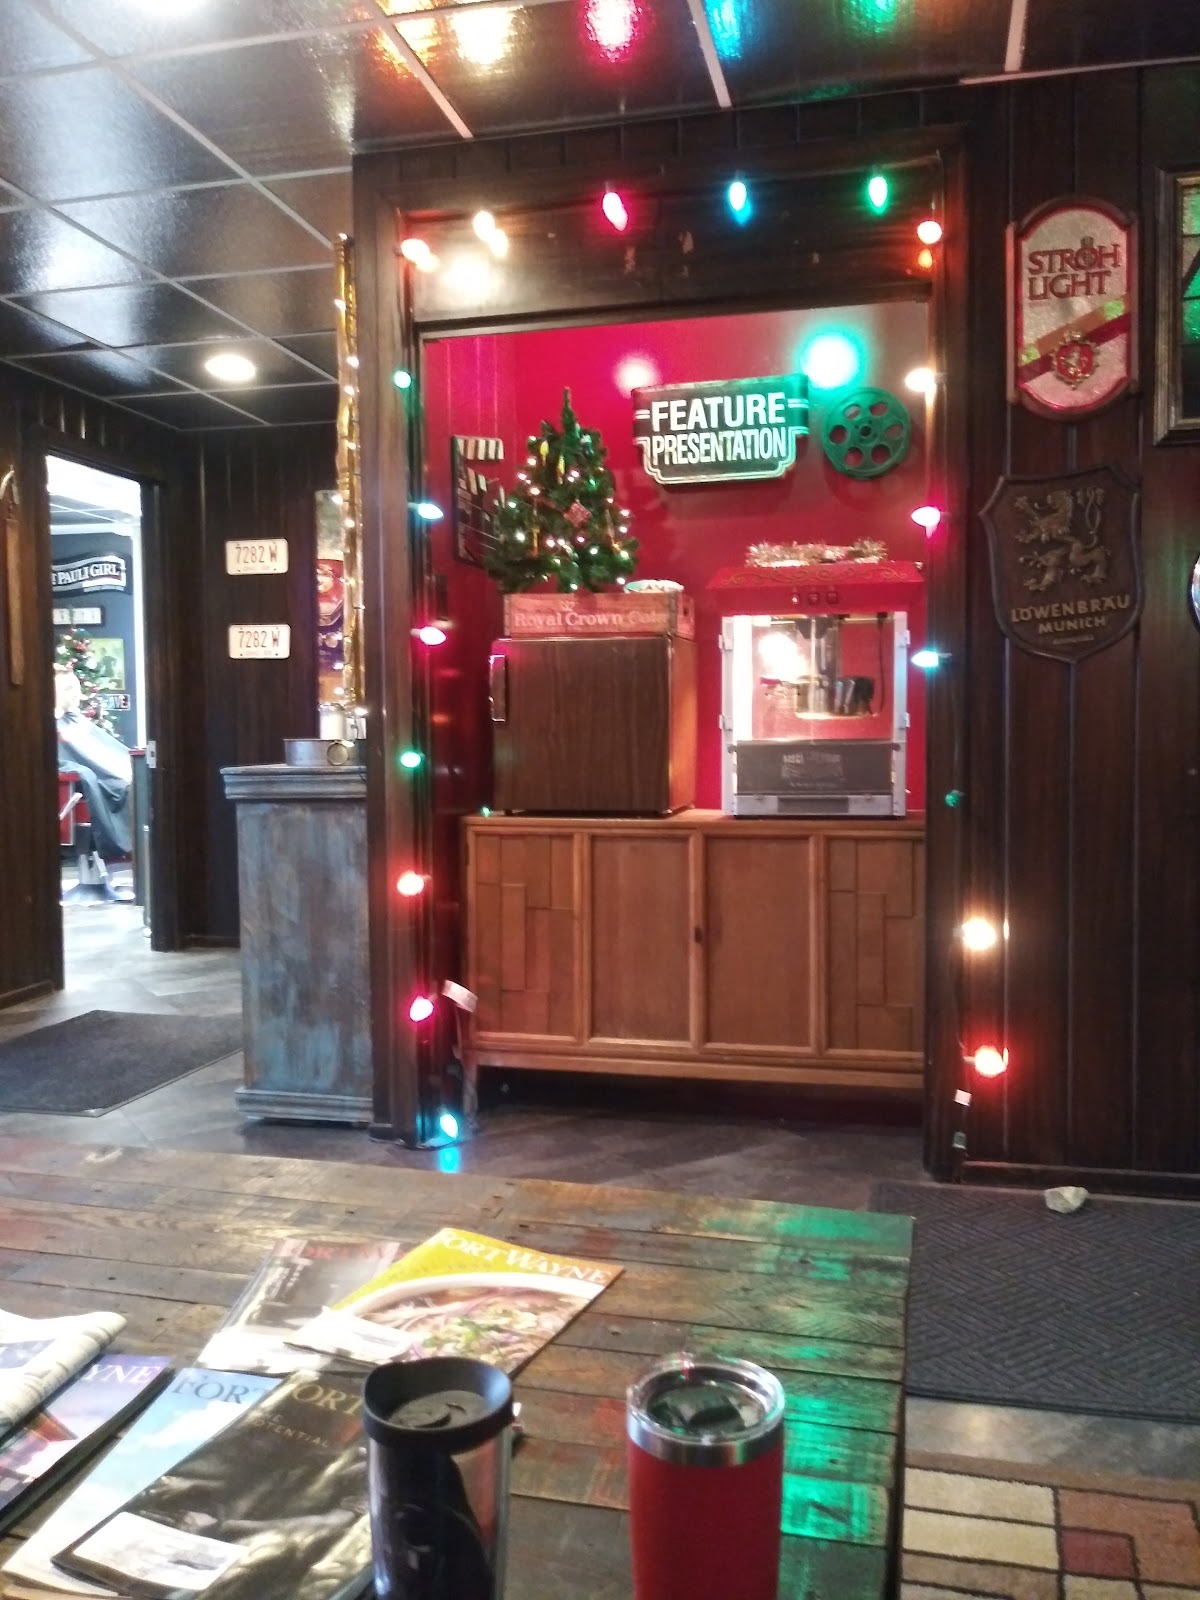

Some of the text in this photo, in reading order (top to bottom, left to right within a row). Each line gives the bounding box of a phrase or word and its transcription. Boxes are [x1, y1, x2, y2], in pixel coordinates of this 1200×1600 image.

[1027, 243, 1120, 275] STROH
[1028, 270, 1112, 301] LIGHT
[651, 392, 786, 432] FEATURE
[652, 426, 787, 466] PRESENTATION
[235, 544, 278, 563] 7282 W
[58, 566, 90, 584] PAULI
[89, 563, 120, 577] GIRL
[514, 613, 562, 629] Royal
[565, 612, 623, 627] Crown
[1038, 615, 1107, 634] MUNICH
[239, 630, 280, 648] 7282 W
[503, 1249, 612, 1284] WAYNE
[82, 1364, 161, 1383] YNE
[291, 1382, 364, 1416] ORT
[253, 1418, 329, 1448] OTENTIAL
